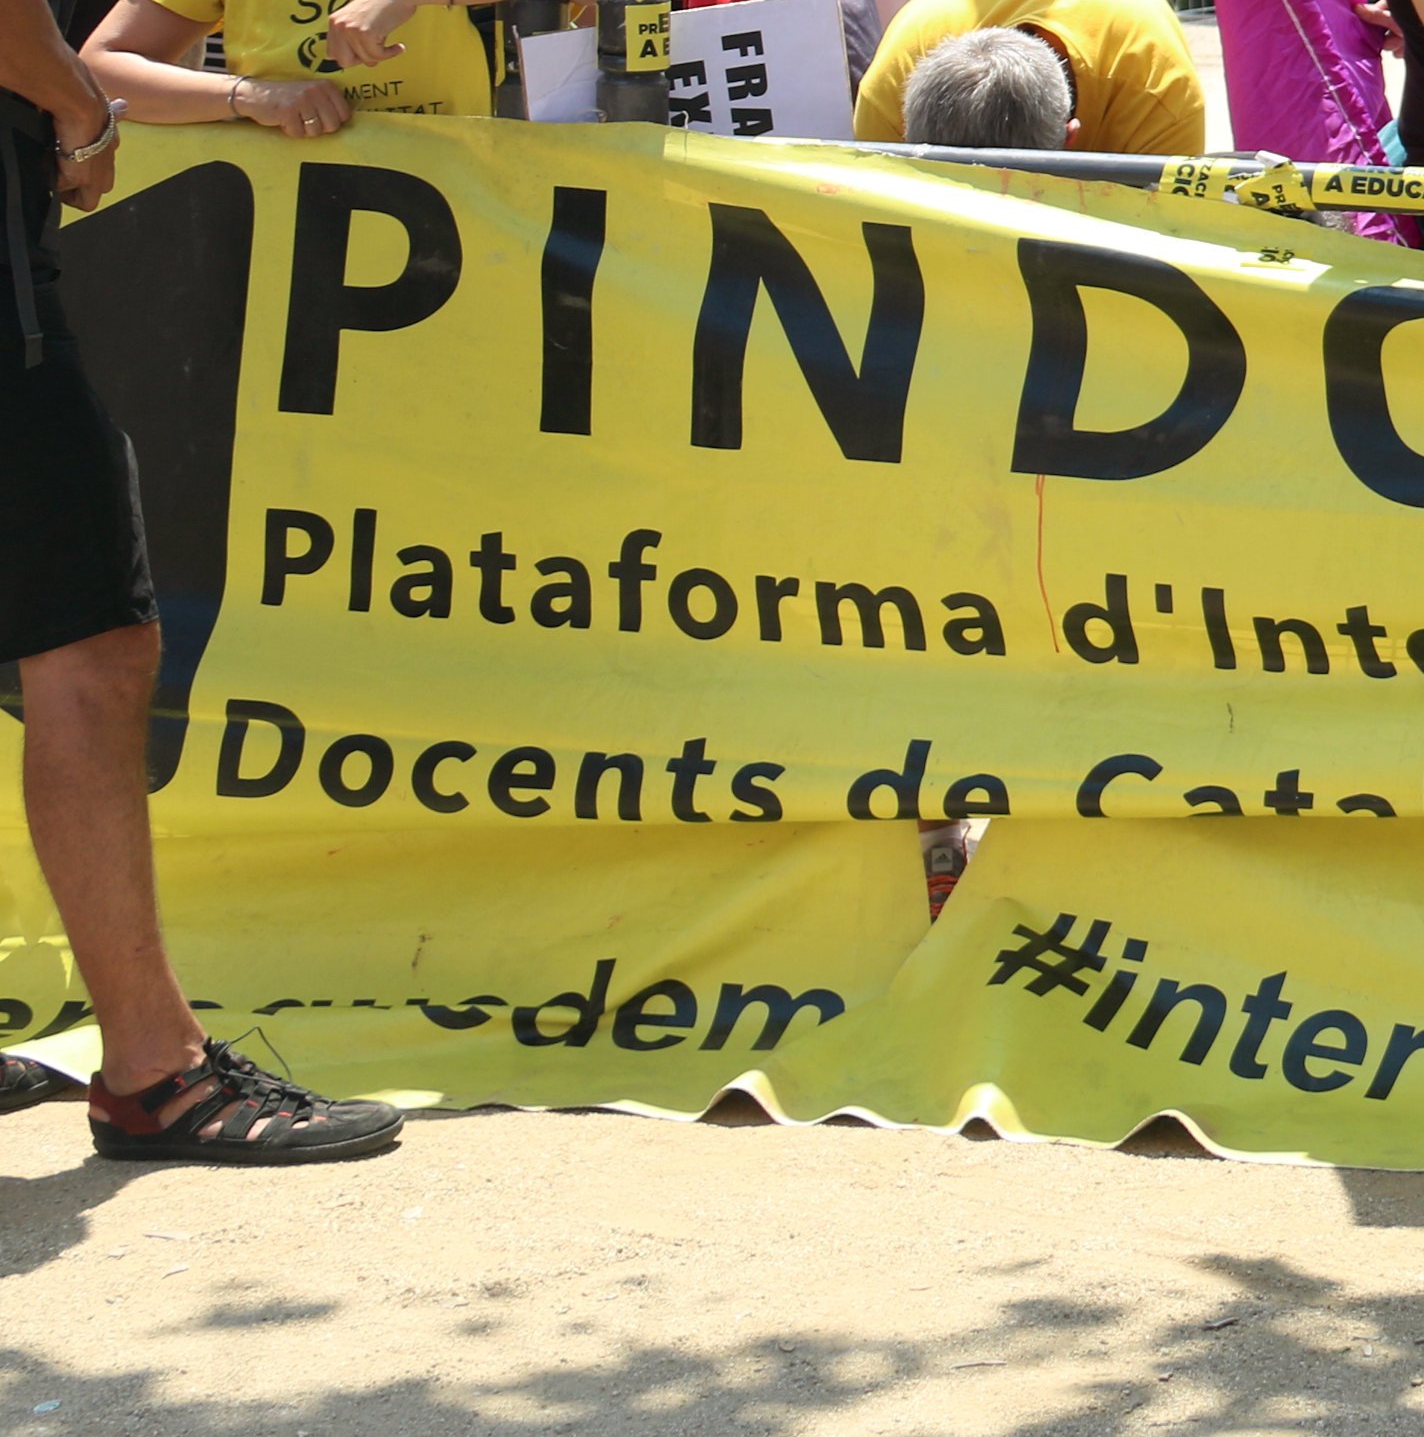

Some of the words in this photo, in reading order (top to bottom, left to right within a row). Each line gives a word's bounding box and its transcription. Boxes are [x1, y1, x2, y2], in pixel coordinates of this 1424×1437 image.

[1324, 175, 1344, 193] A
[260, 507, 1006, 656] Plataforma
[216, 698, 787, 824] Docents
[846, 739, 1011, 820] de
